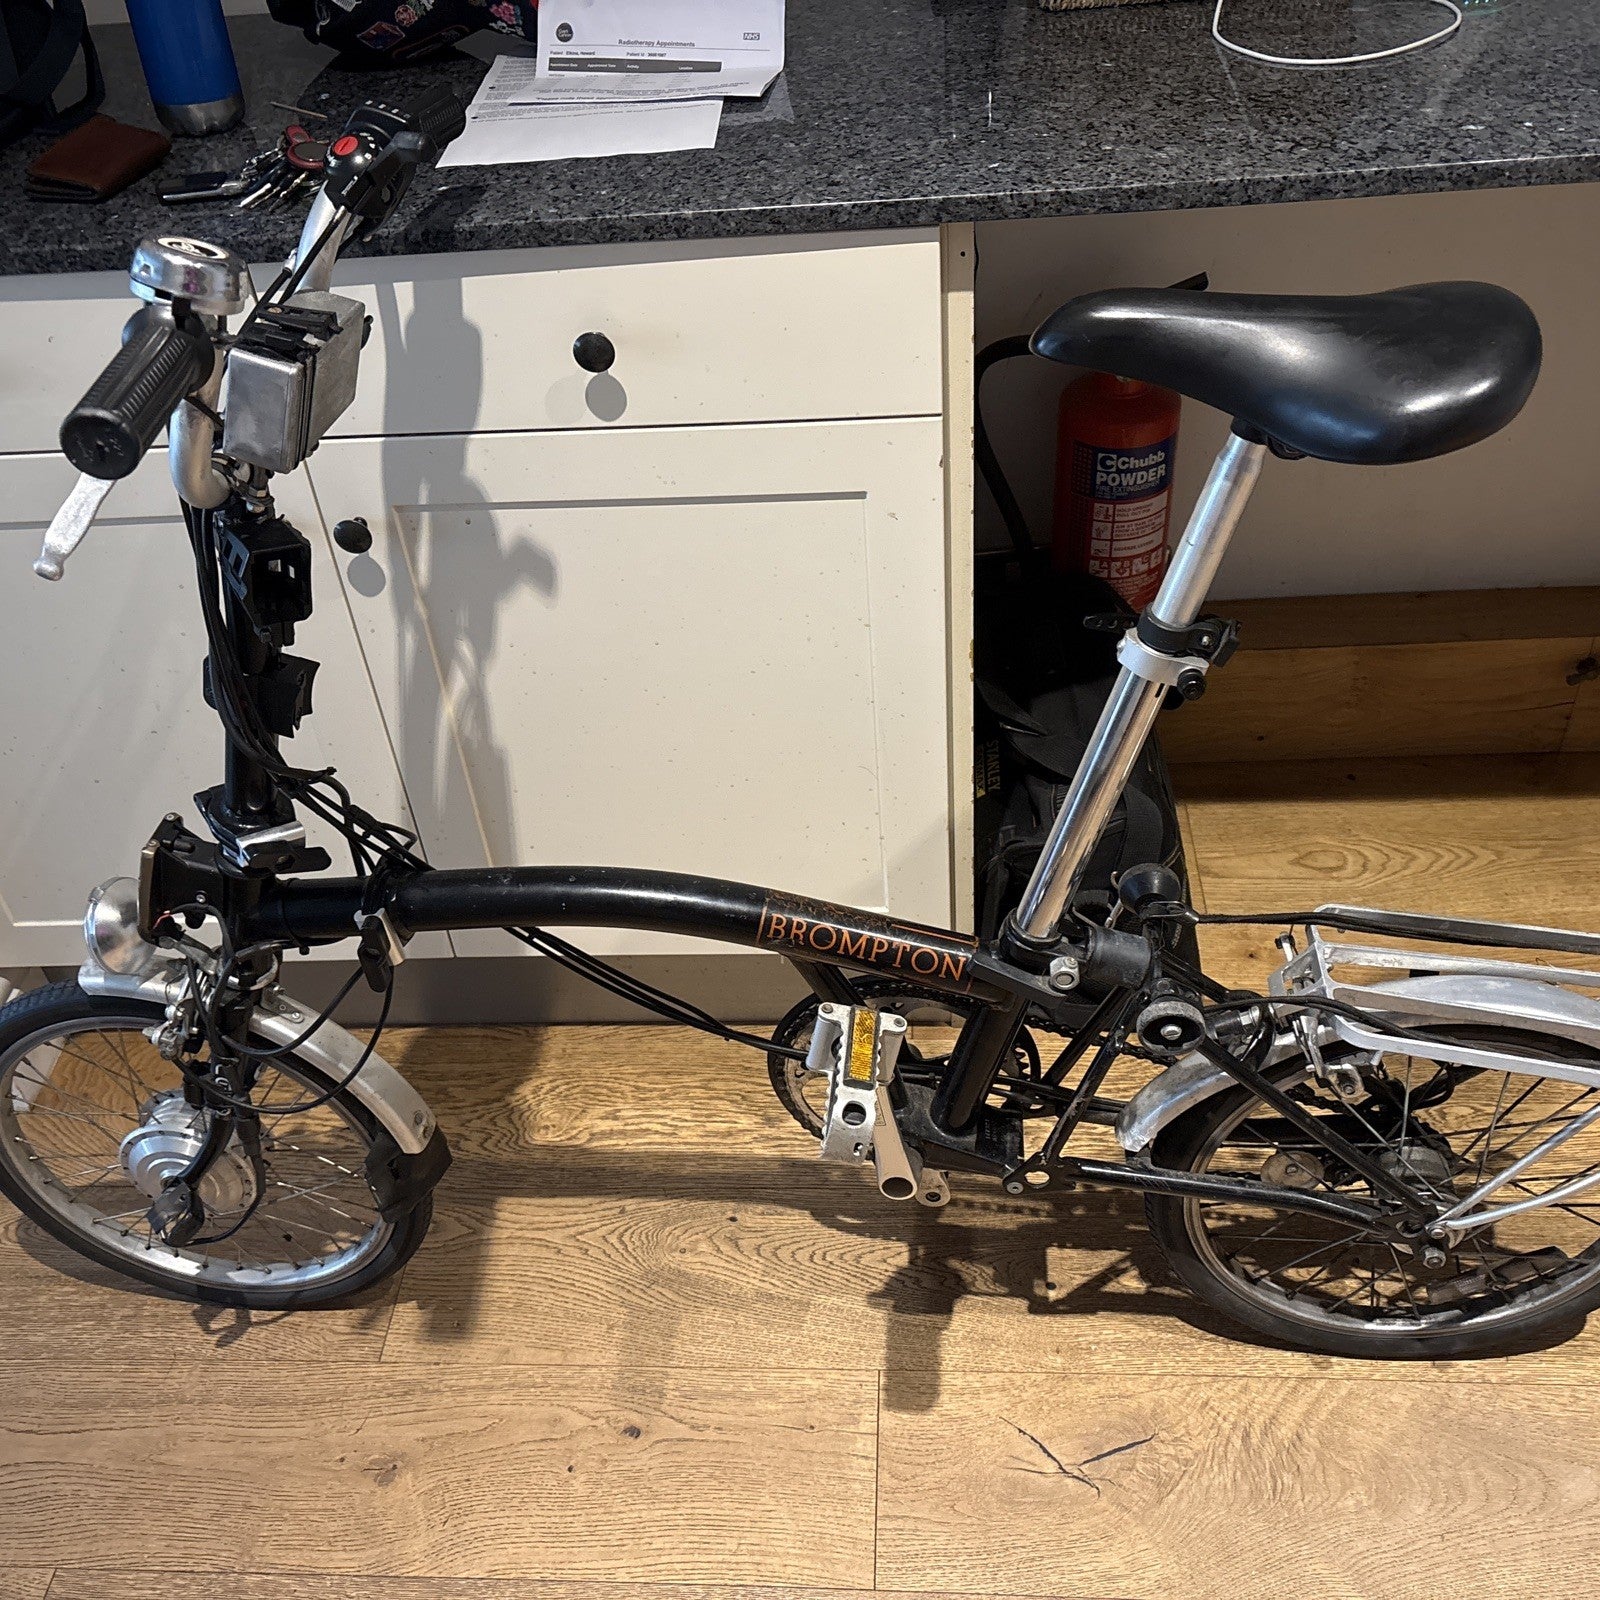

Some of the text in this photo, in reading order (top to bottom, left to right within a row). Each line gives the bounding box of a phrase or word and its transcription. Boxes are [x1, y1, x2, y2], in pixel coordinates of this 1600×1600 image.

[618, 39, 655, 47] Radiotherapy
[1117, 450, 1165, 470] Chubb
[1095, 463, 1167, 487] POWDER
[986, 740, 1000, 790] STANLEY
[767, 913, 967, 982] BROMPTON
